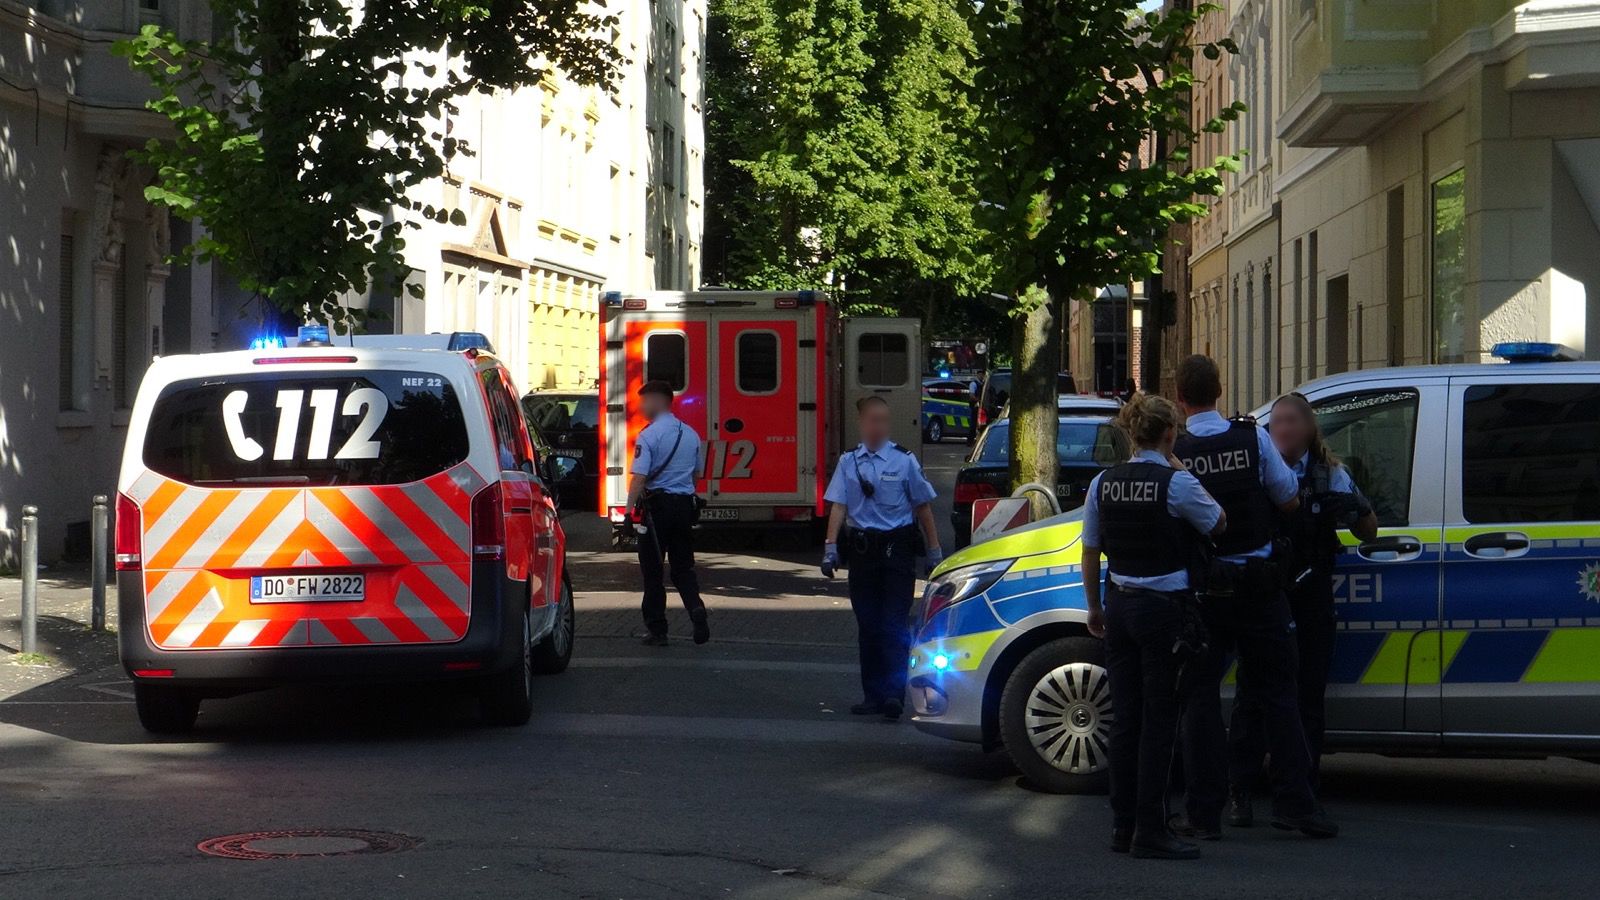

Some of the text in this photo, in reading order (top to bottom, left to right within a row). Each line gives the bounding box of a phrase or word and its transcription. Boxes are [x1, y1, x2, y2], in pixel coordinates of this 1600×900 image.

[402, 377, 442, 387] NEF 22
[273, 387, 389, 461] 112
[1182, 449, 1250, 475] POLIZEI
[1102, 481, 1159, 501] POLIZEI
[264, 577, 363, 596] DO FW 2822
